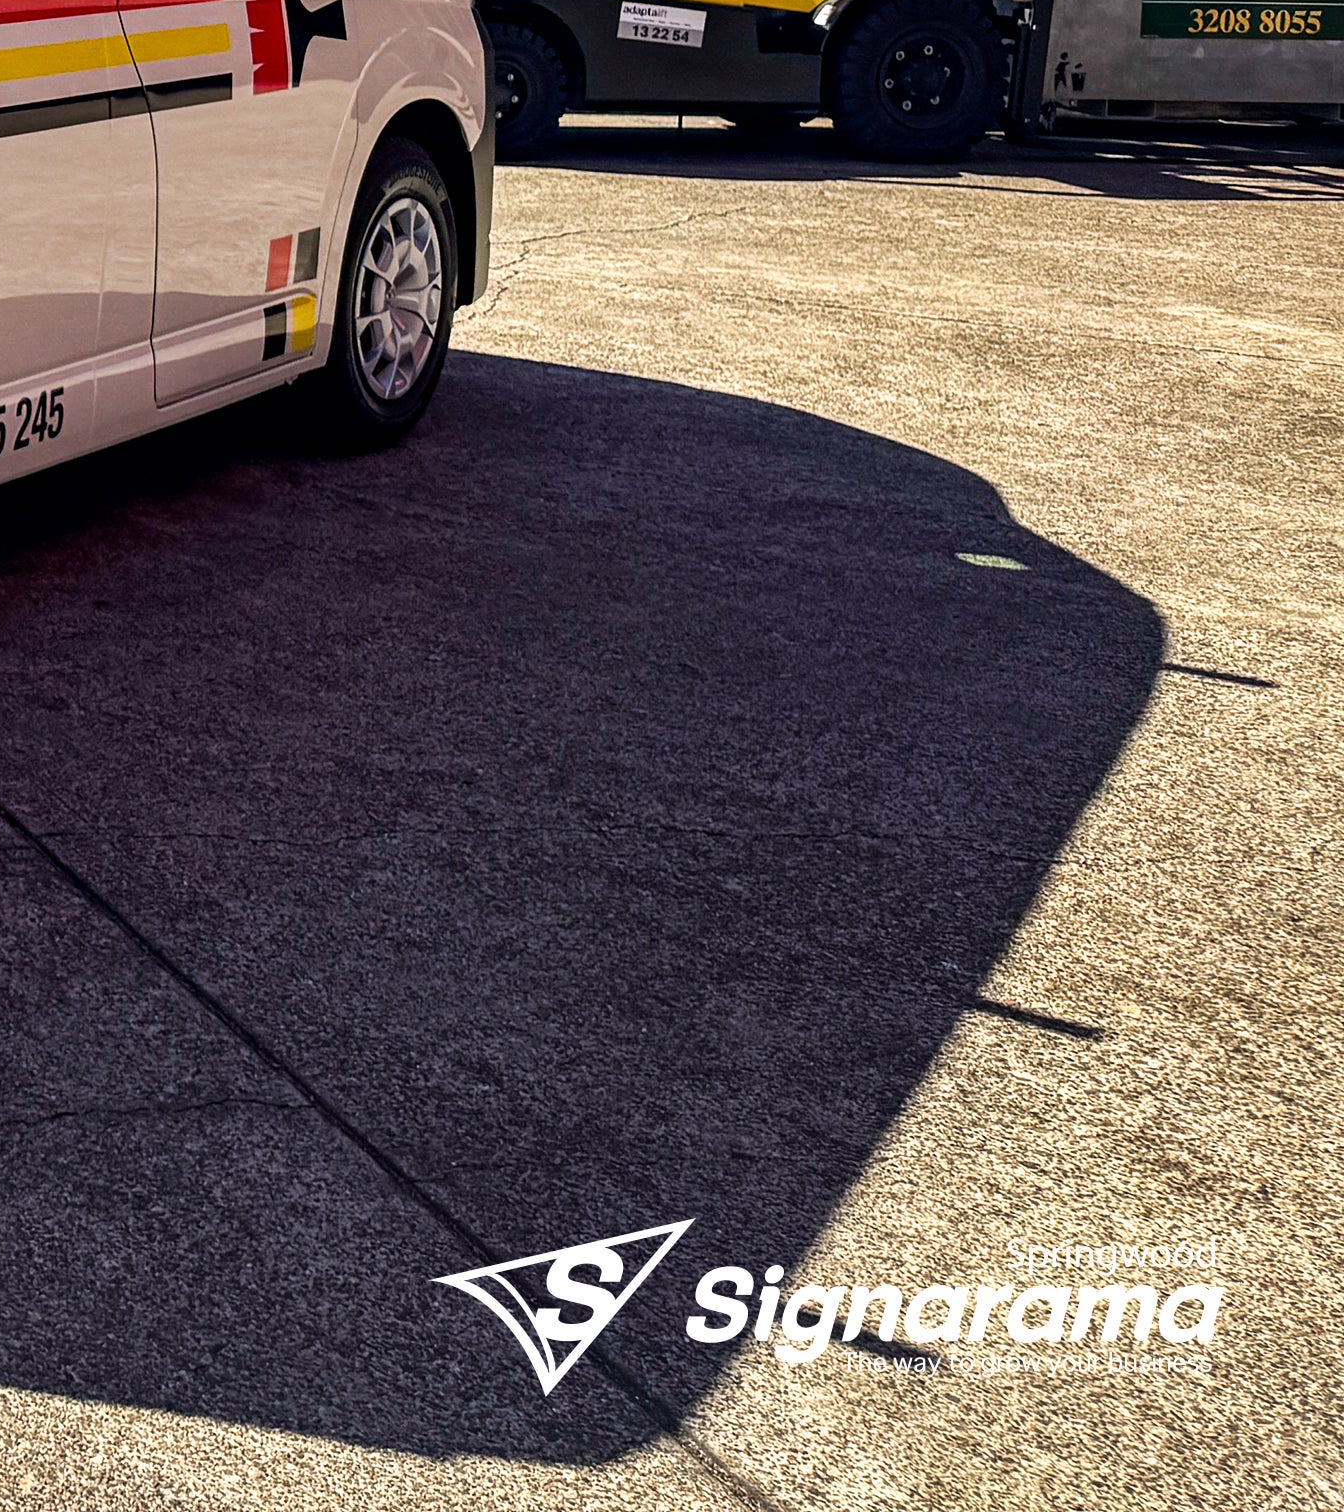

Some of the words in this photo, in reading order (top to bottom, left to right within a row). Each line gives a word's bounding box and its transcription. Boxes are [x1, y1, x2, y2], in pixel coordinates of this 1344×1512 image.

[633, 25, 648, 37] 13
[652, 27, 669, 40] 22
[673, 30, 689, 42] 54
[1188, 9, 1251, 33] 3208
[1259, 9, 1322, 34] 8055
[13, 387, 64, 451] 245
